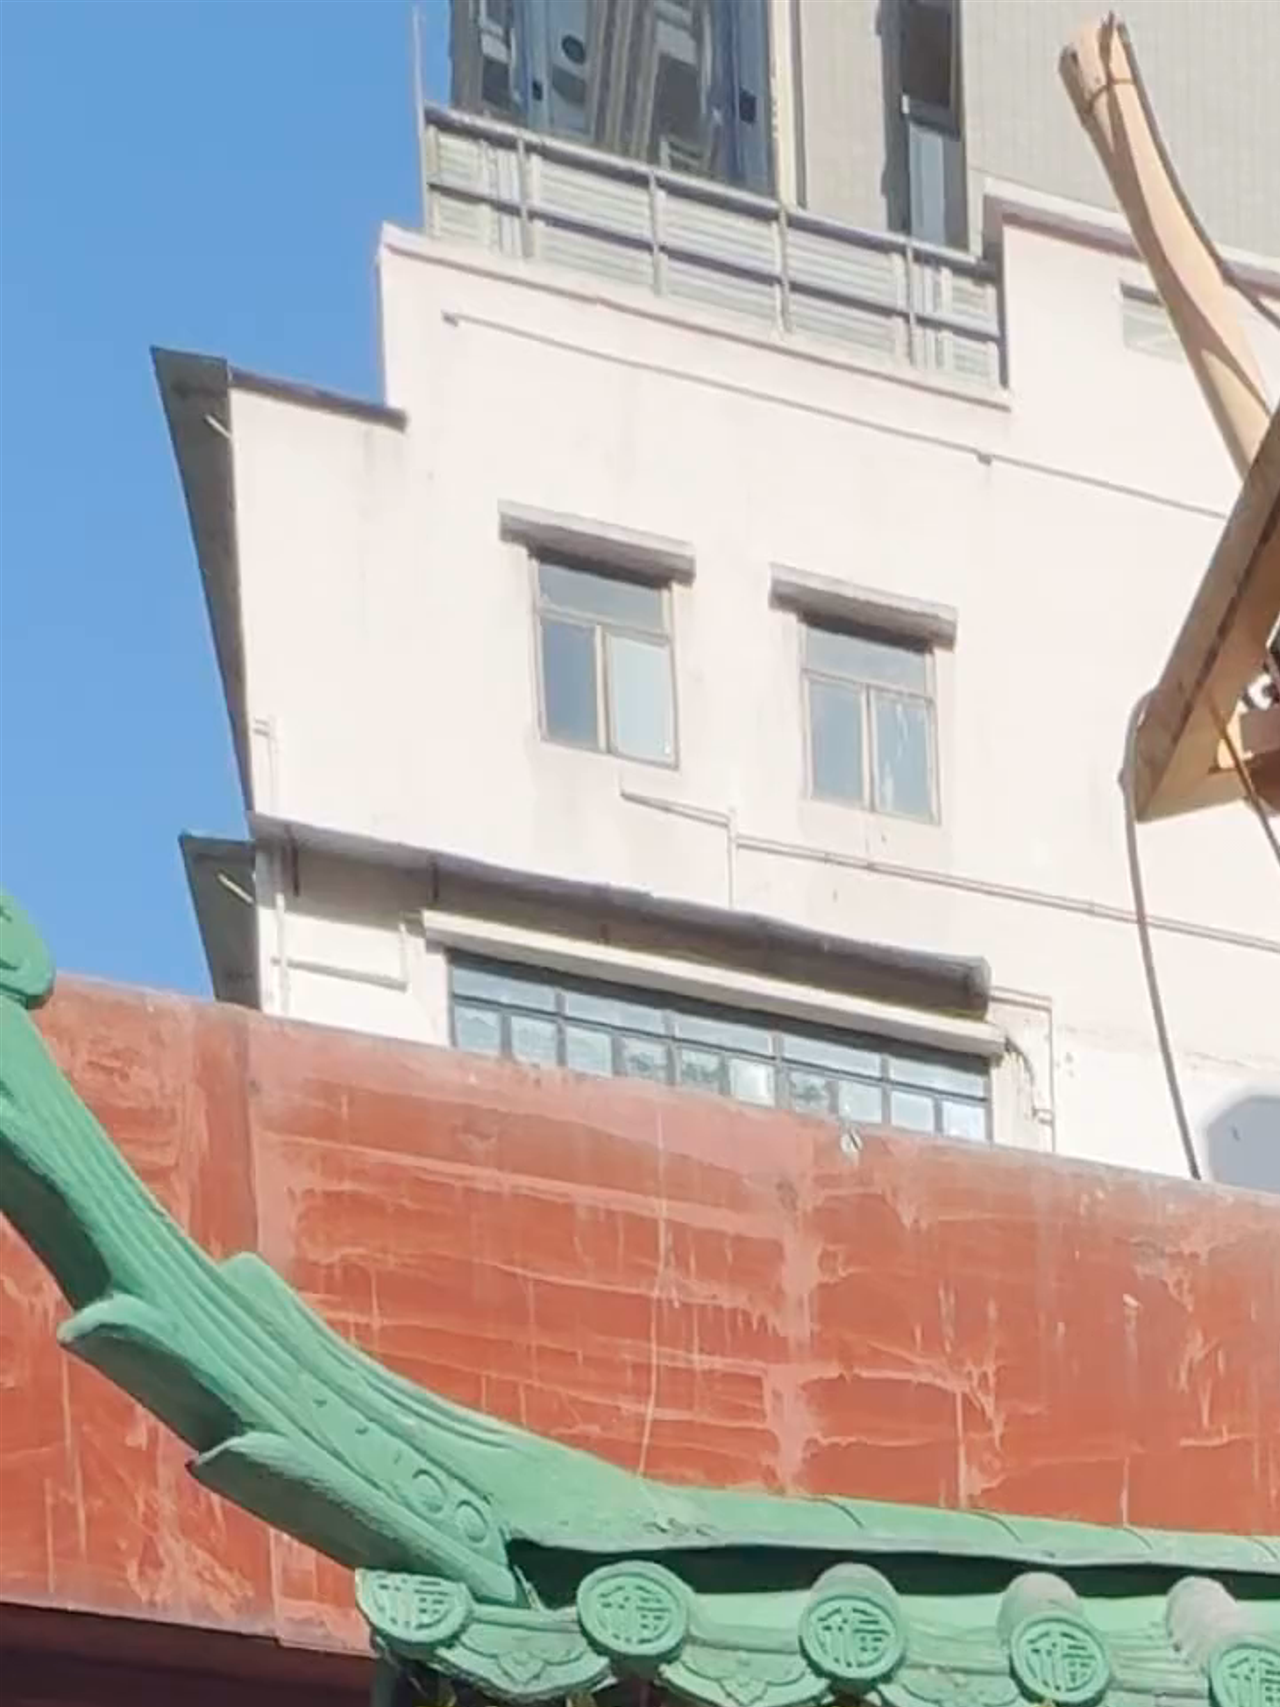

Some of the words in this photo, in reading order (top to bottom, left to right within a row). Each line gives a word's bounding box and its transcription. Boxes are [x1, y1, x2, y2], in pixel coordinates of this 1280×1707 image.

[594, 1584, 674, 1645] 福
[814, 1606, 895, 1667] 福
[1024, 1629, 1099, 1694] 福
